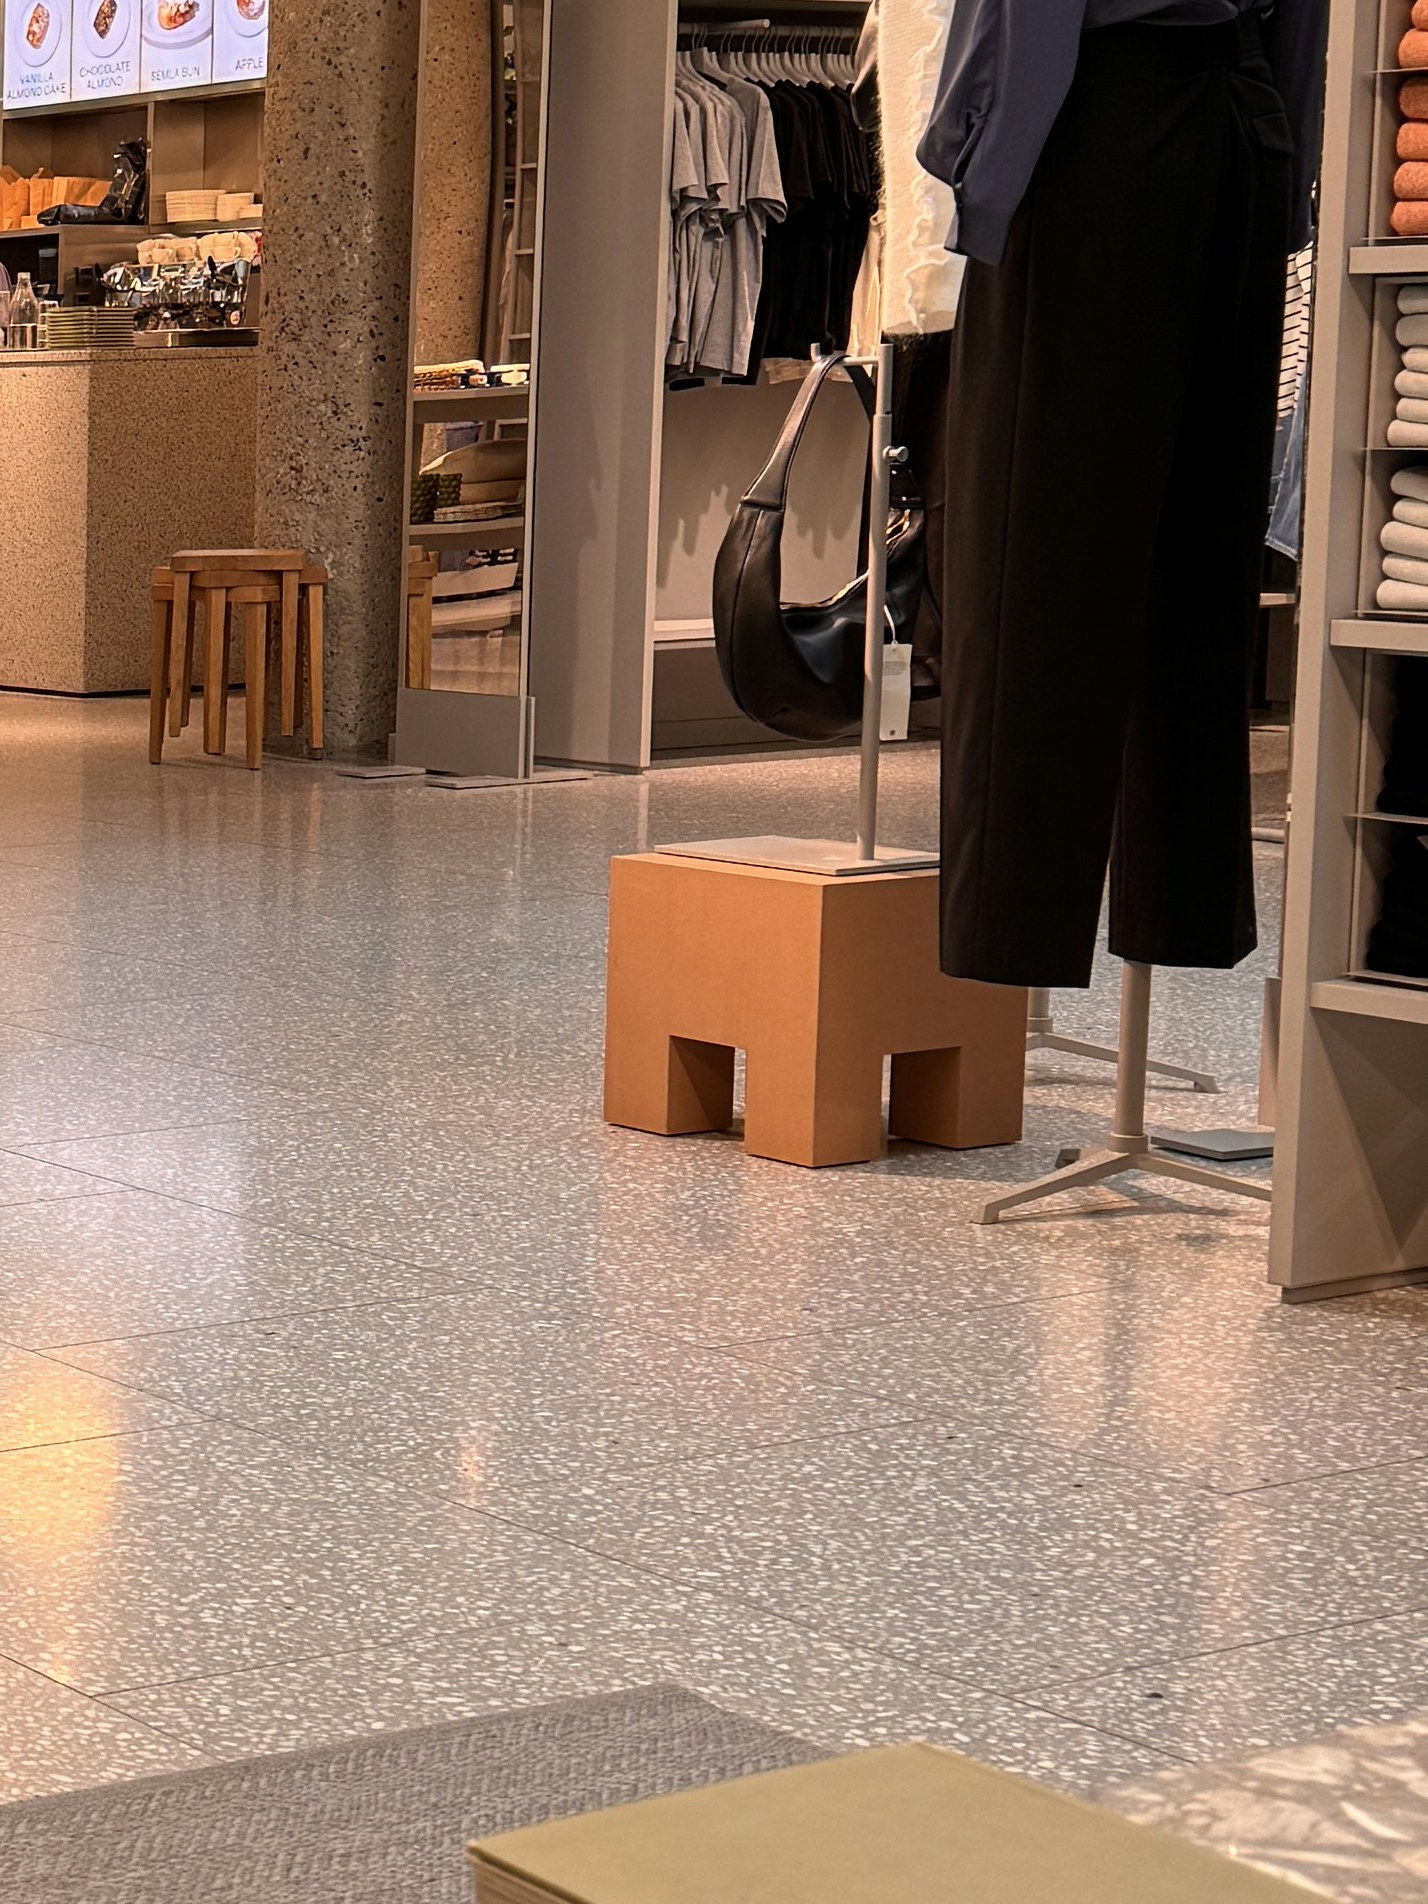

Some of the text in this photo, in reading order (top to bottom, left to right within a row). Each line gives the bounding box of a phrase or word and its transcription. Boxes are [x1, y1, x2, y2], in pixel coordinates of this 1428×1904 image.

[80, 60, 131, 78] CHOCOLATE
[235, 56, 265, 71] APPLE
[20, 71, 54, 85] VANILLA
[182, 66, 201, 77] BUN
[87, 75, 124, 90] ALMOND
[7, 82, 67, 100] ALMOND CAKE
